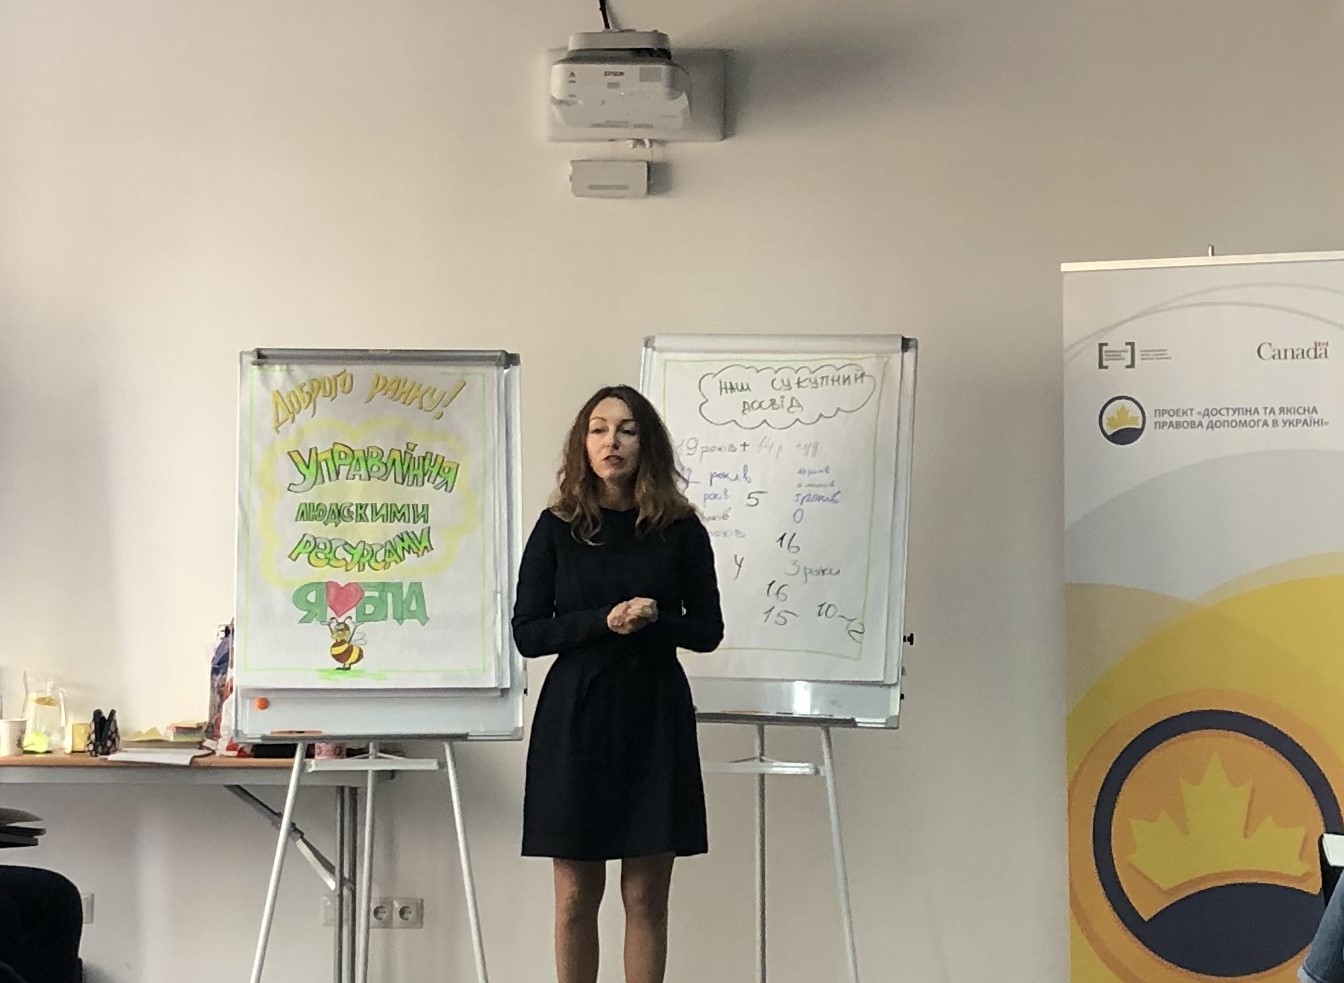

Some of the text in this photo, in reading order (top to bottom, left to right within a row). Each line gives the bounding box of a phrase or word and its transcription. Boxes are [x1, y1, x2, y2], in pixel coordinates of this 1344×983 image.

[1256, 341, 1330, 361] Canada
[1153, 405, 1319, 419] ПРОЕКТ «ДОСТУПНА ТА ЯКІСНА
[1153, 415, 1330, 432] ПРАВОВА ДОПОМОГА В УКРАЇНІ»
[286, 441, 461, 494] УПРАВЛІННЯ
[745, 490, 768, 508] 5
[287, 525, 435, 573] РЕСУРСАМИ
[775, 531, 801, 554] 16
